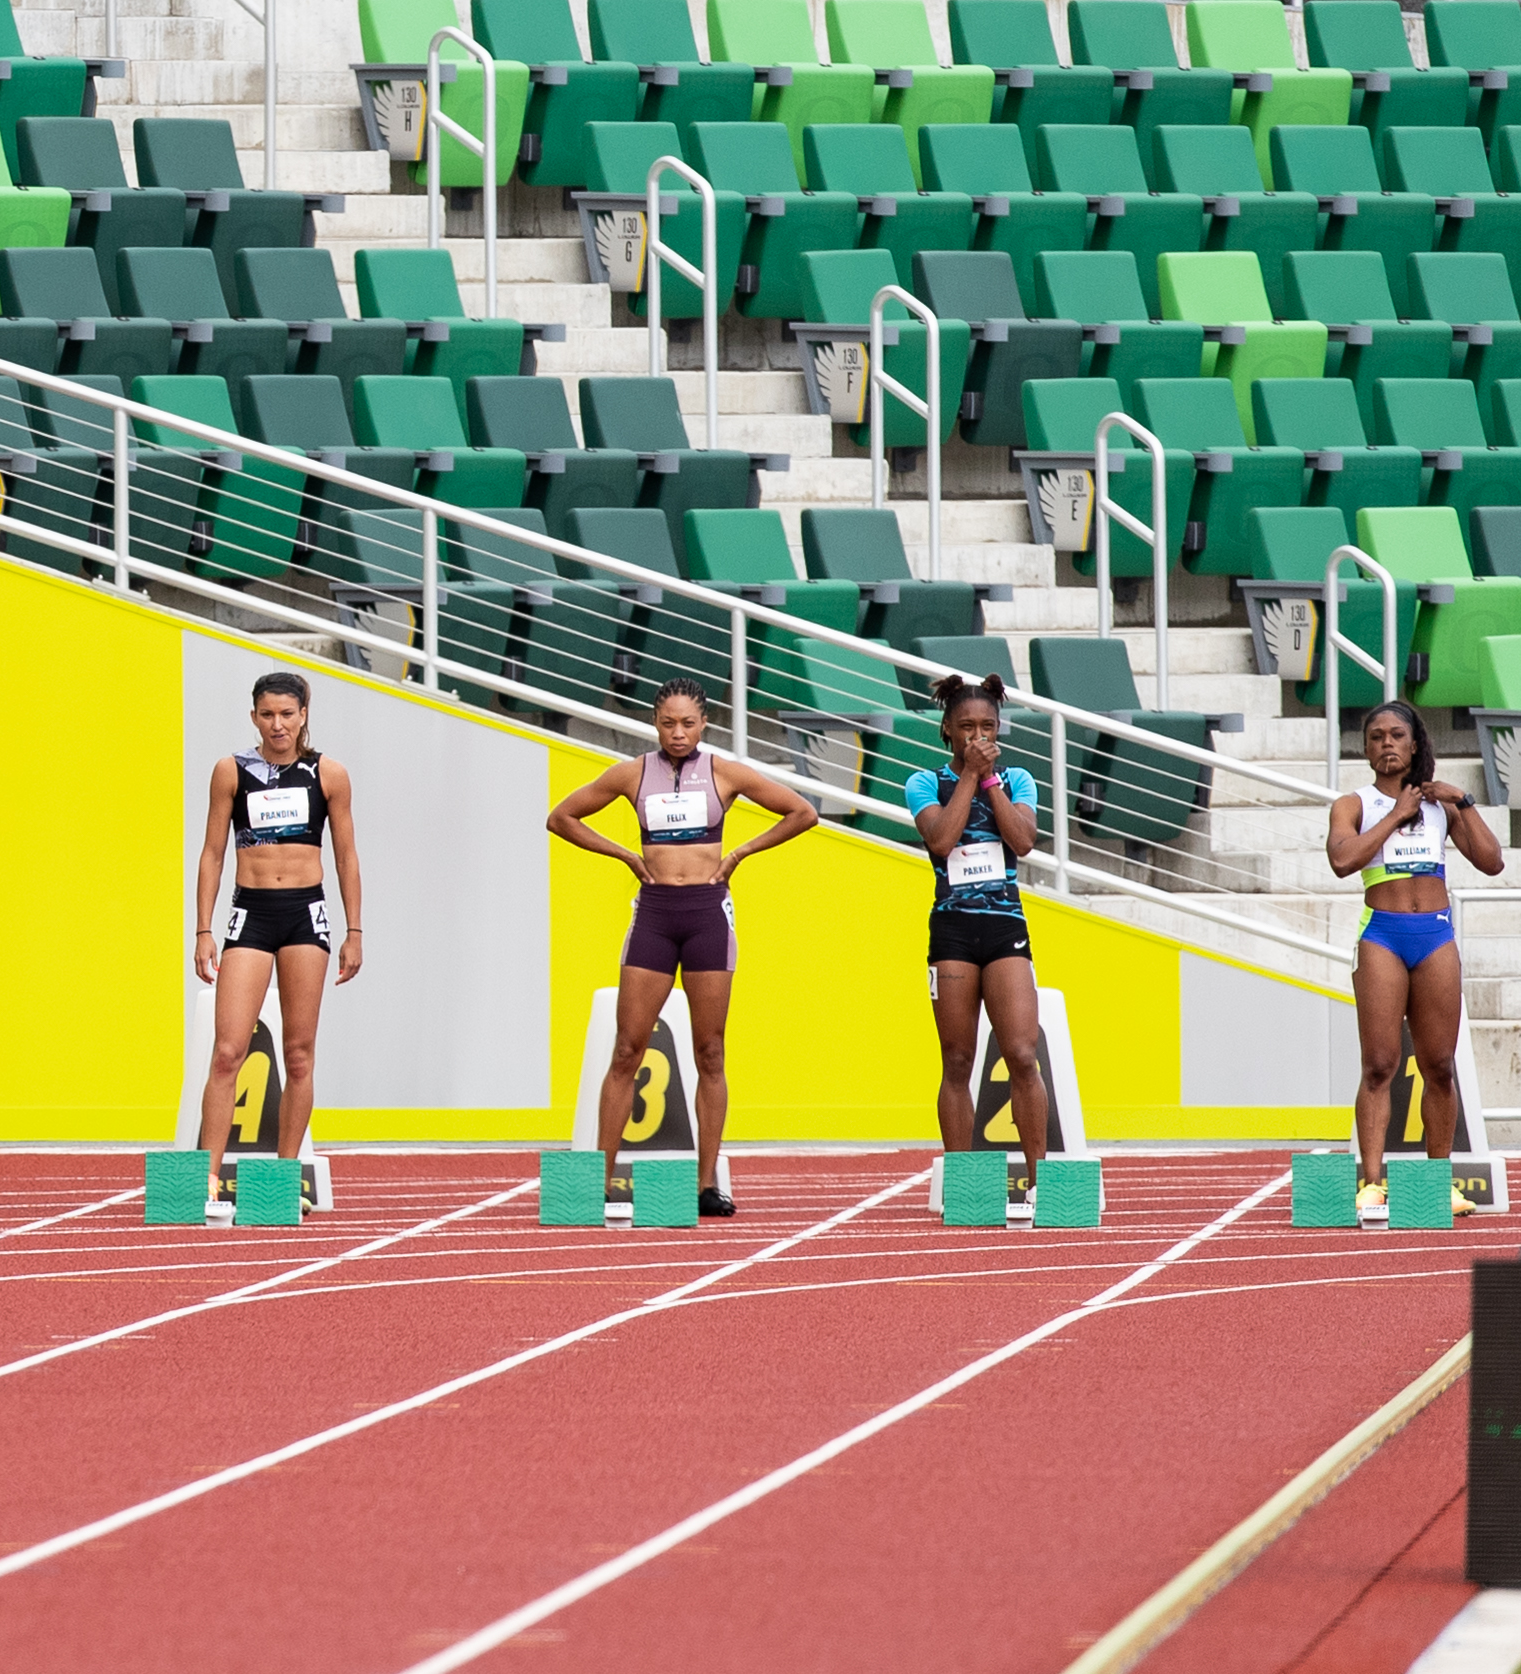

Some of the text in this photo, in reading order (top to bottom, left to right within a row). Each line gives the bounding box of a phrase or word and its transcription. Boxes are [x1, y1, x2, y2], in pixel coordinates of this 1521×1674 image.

[401, 86, 417, 103] 130
[404, 110, 412, 132] H
[622, 217, 637, 234] 130
[625, 240, 632, 262] G
[843, 348, 858, 364] 130
[847, 371, 854, 393] F
[1067, 474, 1084, 492] 130
[1071, 499, 1078, 521] E
[1291, 604, 1306, 622] 130
[1294, 628, 1301, 651] D
[260, 809, 298, 821] PRANDINI
[666, 813, 687, 823] FELIX
[1394, 847, 1431, 856] WILLIAMS
[963, 865, 993, 876] PARKER
[227, 910, 239, 937] 4
[315, 904, 330, 930] 4
[231, 1051, 271, 1143] 4
[621, 1048, 671, 1143] 3
[1403, 1055, 1425, 1142] 1
